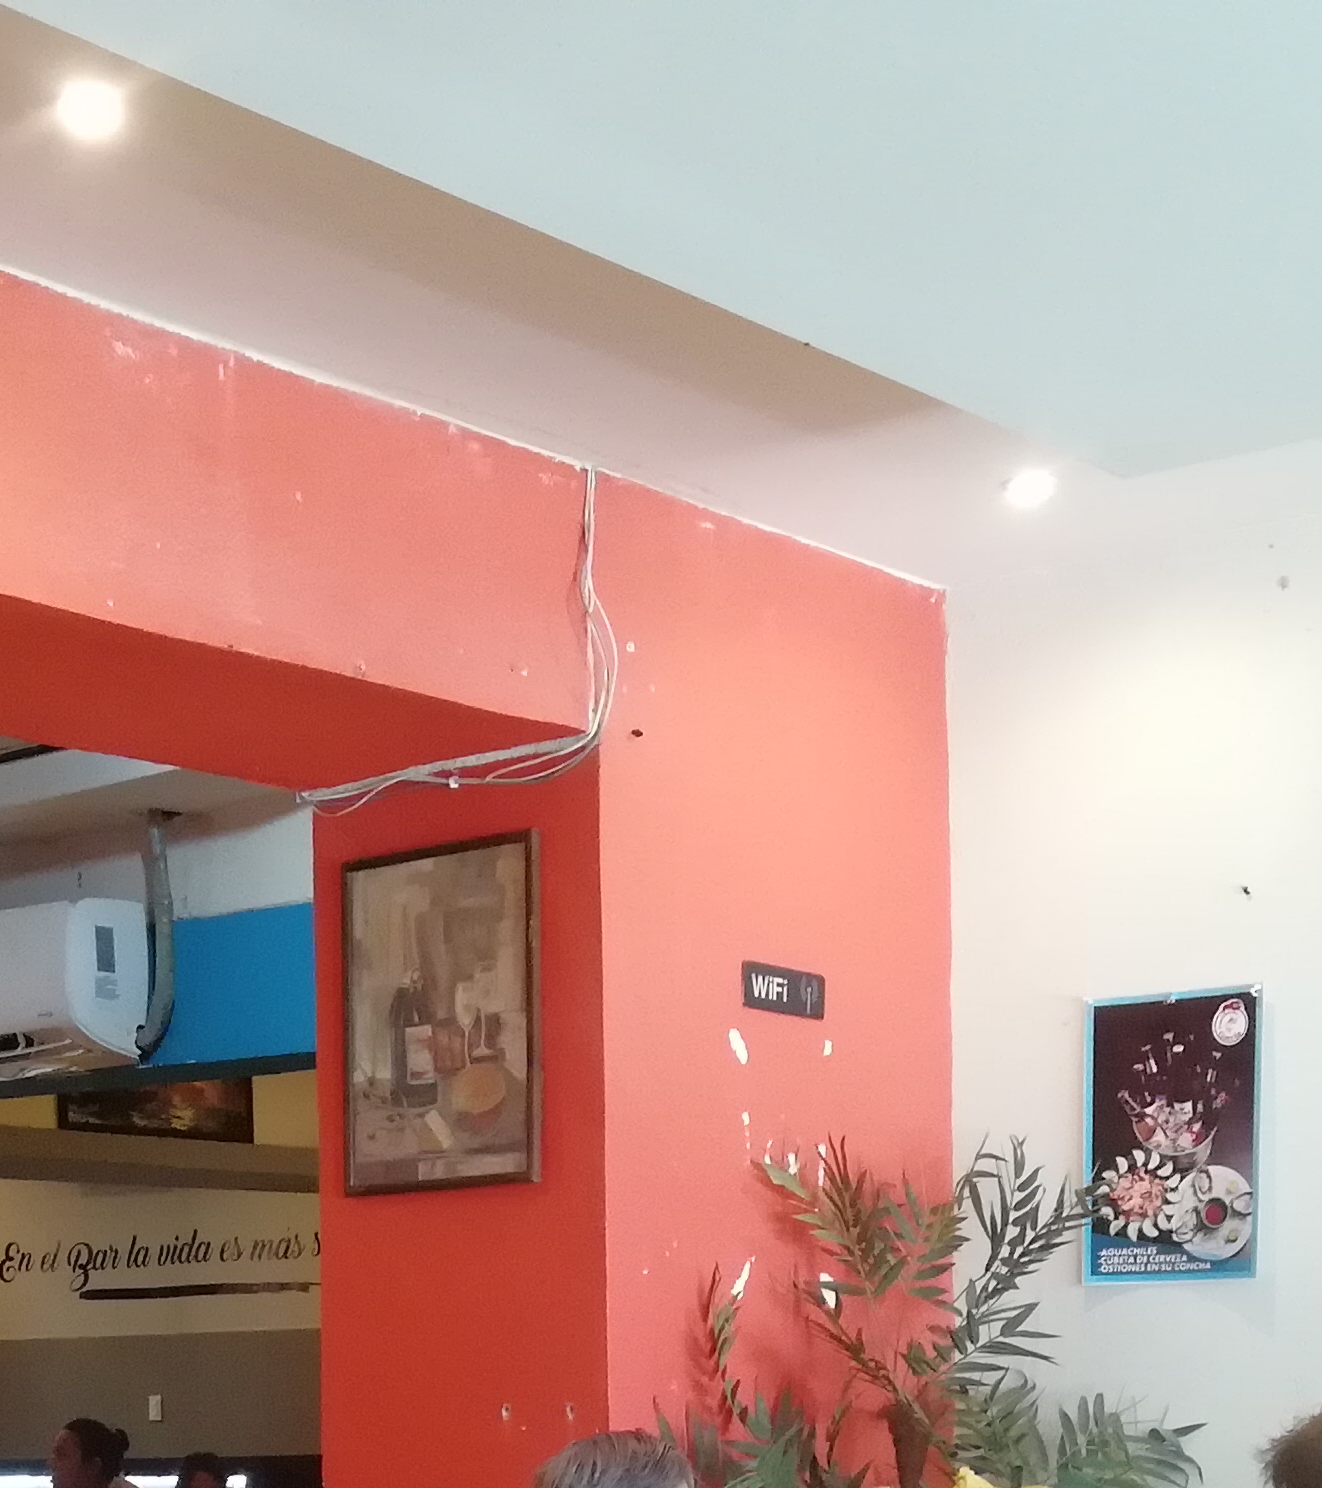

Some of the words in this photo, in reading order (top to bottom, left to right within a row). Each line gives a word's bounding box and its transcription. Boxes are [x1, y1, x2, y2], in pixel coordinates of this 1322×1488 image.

[751, 972, 789, 1003] WiFi
[40, 1239, 62, 1273] el
[67, 1241, 121, 1292] Bar
[127, 1234, 152, 1269] la
[158, 1228, 213, 1267] vida
[219, 1236, 244, 1262] es
[250, 1226, 306, 1261] más
